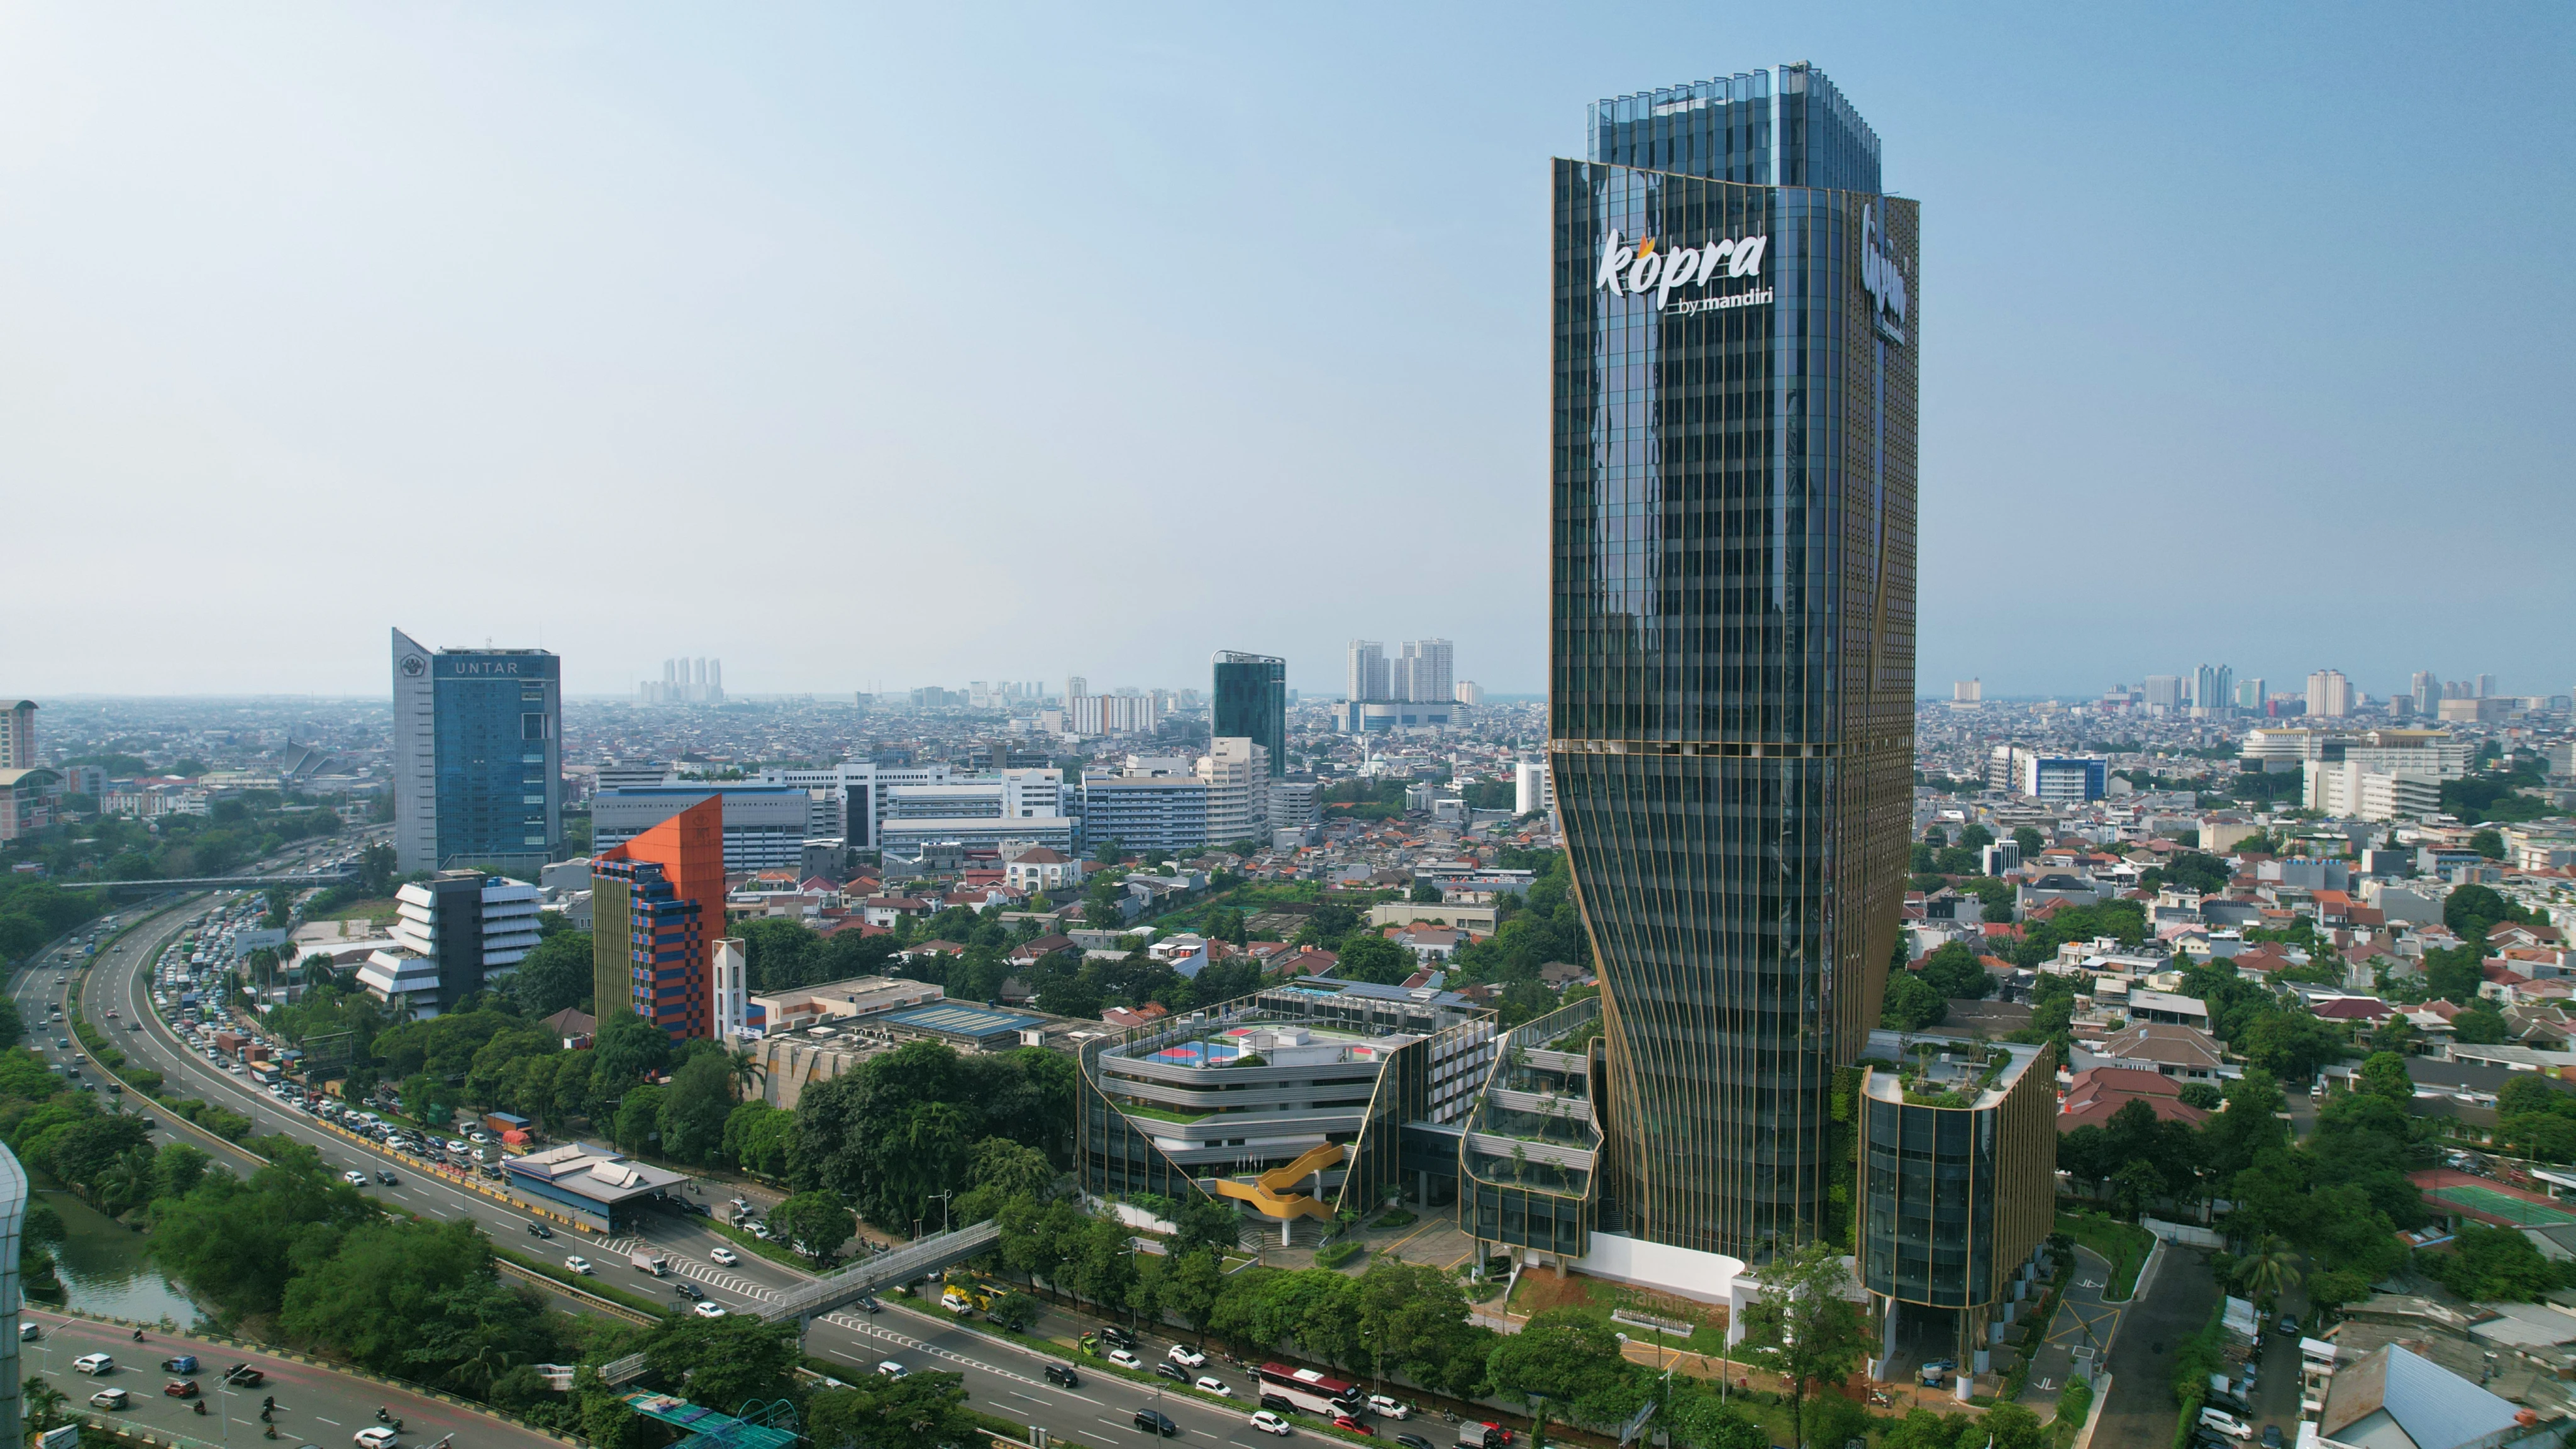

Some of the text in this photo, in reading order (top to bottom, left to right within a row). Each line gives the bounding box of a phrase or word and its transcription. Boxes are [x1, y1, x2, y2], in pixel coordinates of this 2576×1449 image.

[1596, 228, 1767, 311] kopra
[1679, 286, 1773, 317] by mandiri
[455, 662, 518, 674] UNTAR
